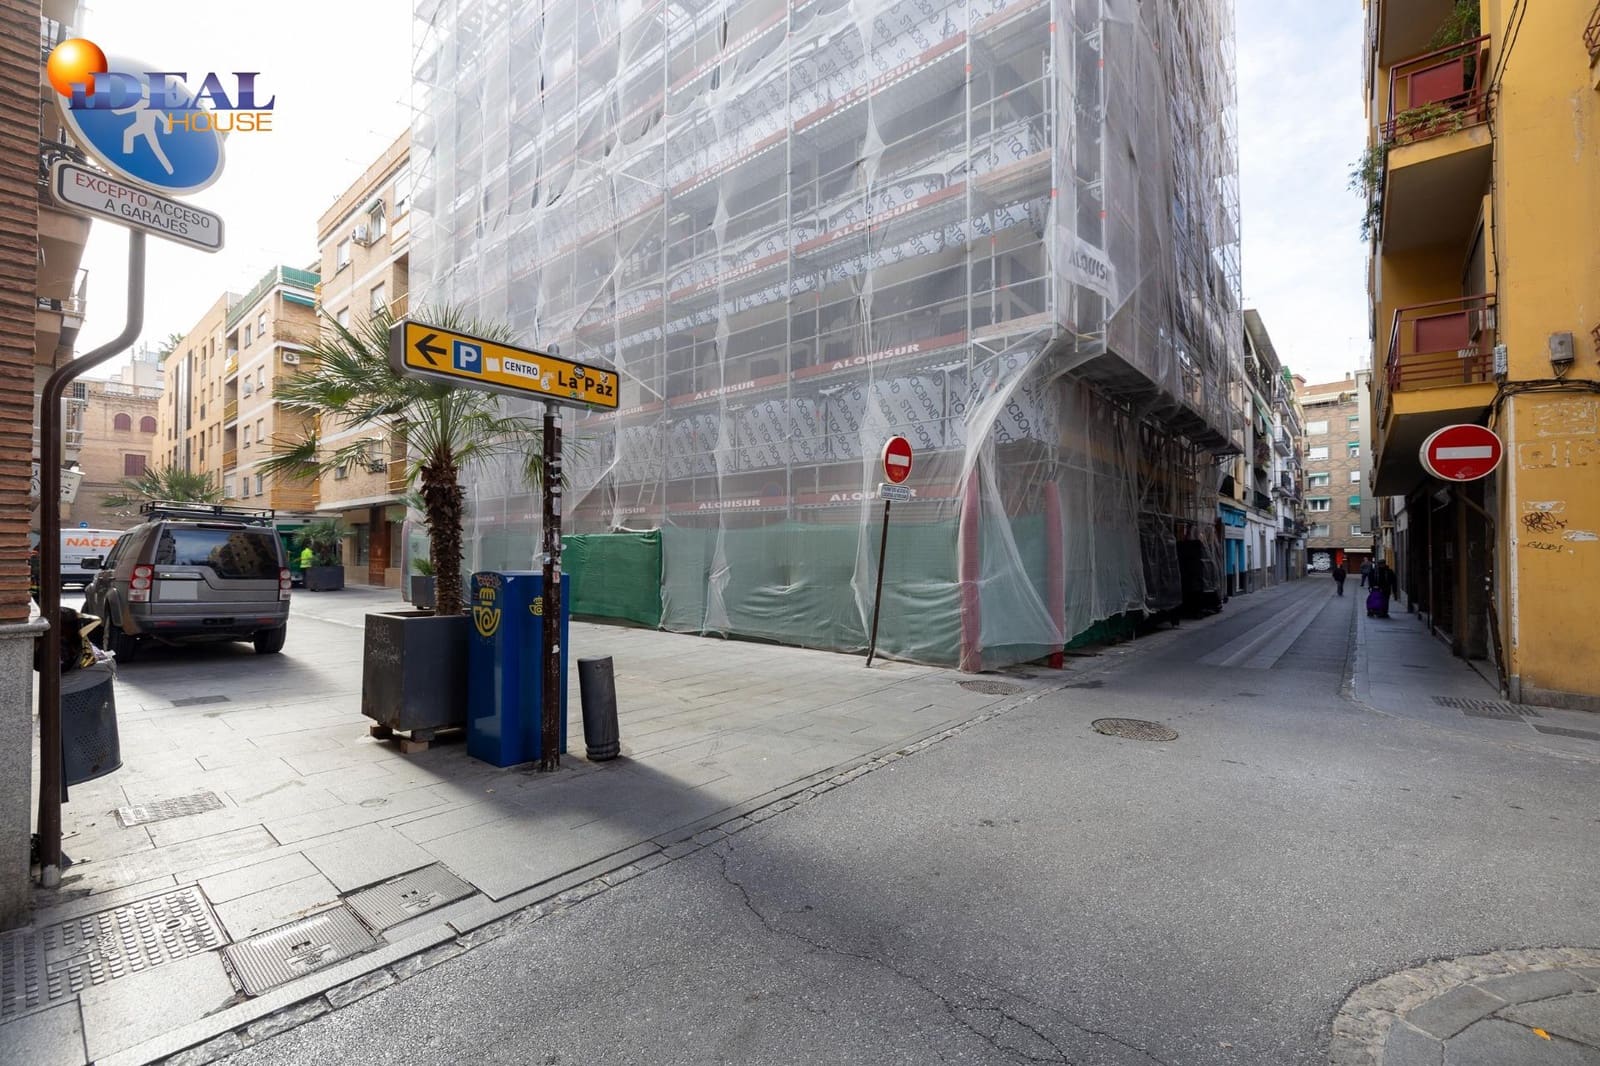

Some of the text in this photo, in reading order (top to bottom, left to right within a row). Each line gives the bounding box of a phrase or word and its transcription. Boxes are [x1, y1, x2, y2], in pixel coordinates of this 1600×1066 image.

[75, 172, 210, 229] EXCEPTO ACCESO
[104, 199, 189, 235] A GARAJES
[460, 345, 613, 397] P CENTRO La Paz
[65, 537, 117, 548] NACEX
